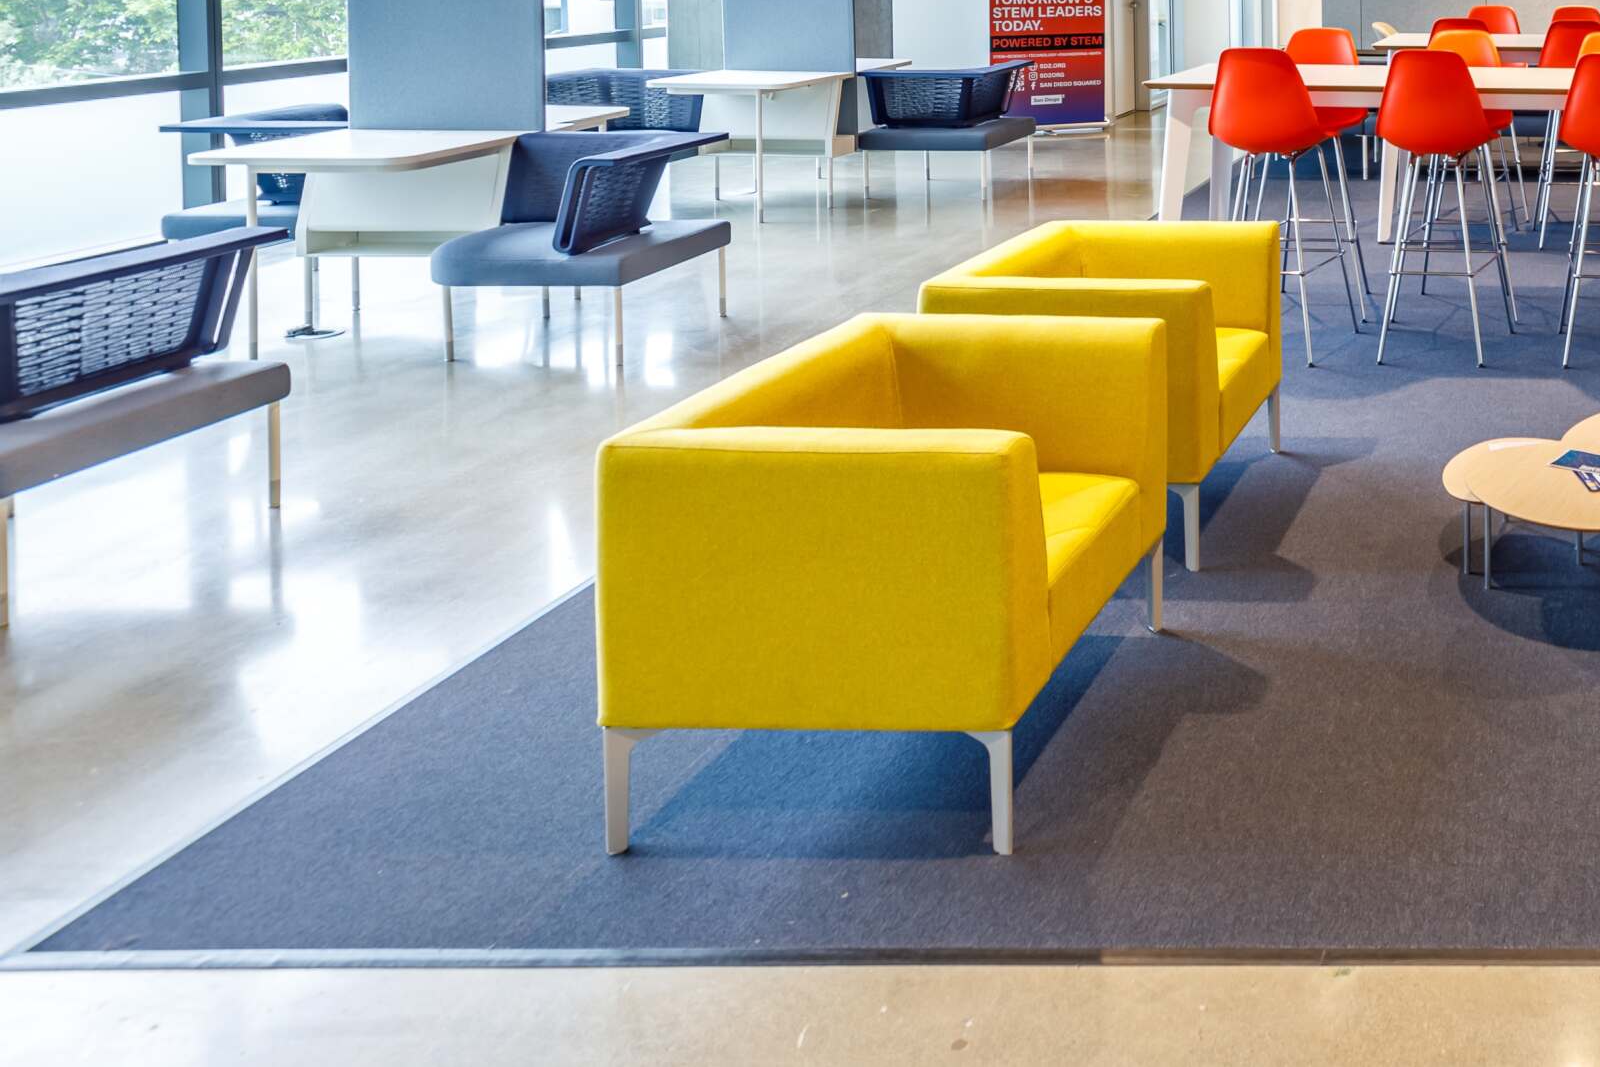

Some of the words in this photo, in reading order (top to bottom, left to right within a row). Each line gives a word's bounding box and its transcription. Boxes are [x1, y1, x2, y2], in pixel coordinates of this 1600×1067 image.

[993, 6, 1034, 18] STEM
[1038, 5, 1102, 17] LEADERS
[993, 19, 1044, 32] TODAY.
[992, 37, 1051, 48] POWERED
[1054, 37, 1068, 46] BY
[1070, 36, 1102, 45] STEM
